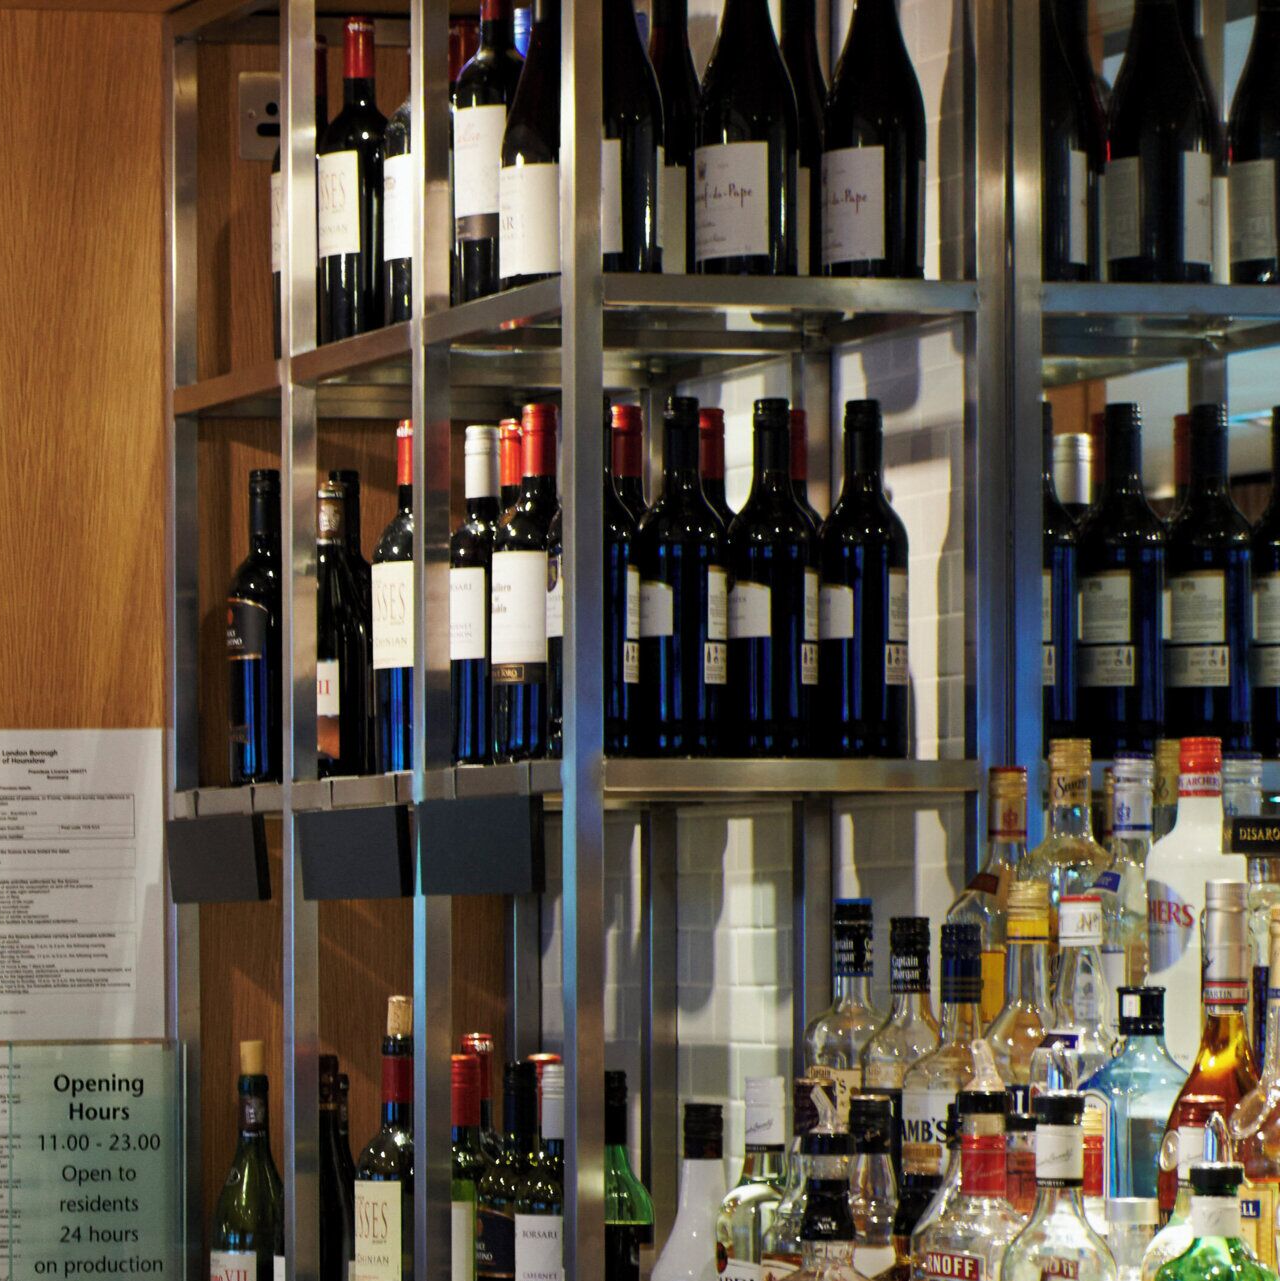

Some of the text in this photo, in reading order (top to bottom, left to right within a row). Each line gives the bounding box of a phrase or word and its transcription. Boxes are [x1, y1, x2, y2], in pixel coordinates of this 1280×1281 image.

[53, 1074, 144, 1097] Opening
[69, 1103, 130, 1121] Hours
[901, 1117, 948, 1143] AMB'S
[39, 1134, 90, 1151] 11.00
[109, 1133, 161, 1151] 23.00
[62, 1165, 137, 1186] Open to
[59, 1195, 139, 1213] residents
[59, 1225, 139, 1243] 24 hours
[34, 1255, 163, 1278] on production
[928, 1253, 974, 1278] RNOFF
